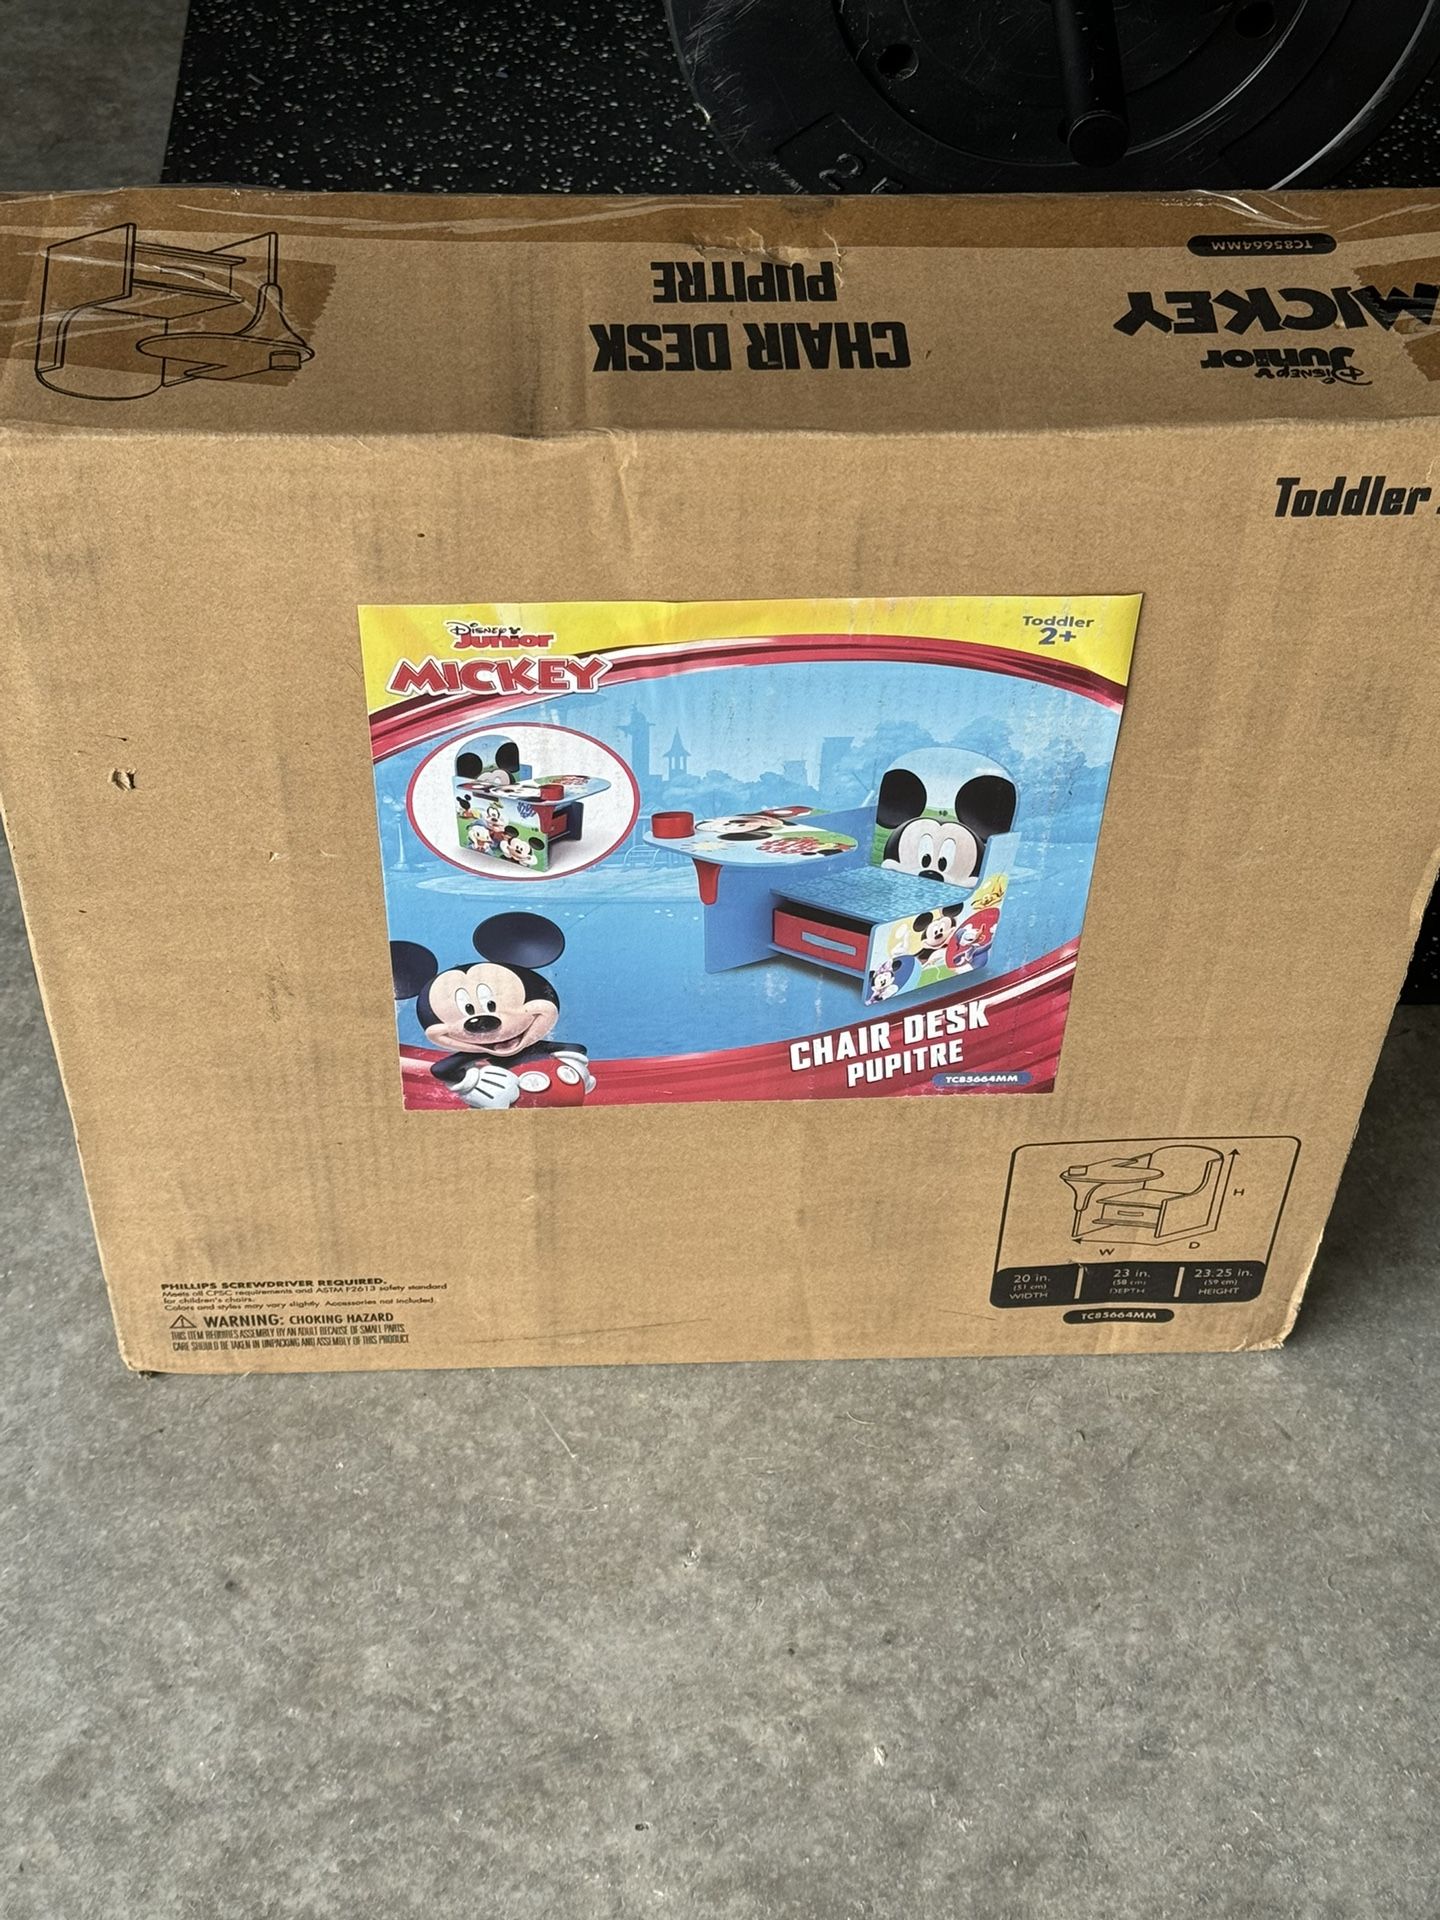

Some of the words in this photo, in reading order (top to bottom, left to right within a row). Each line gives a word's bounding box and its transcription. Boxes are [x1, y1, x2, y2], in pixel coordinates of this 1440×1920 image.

[1211, 240, 1313, 250] TC85664MM
[650, 261, 837, 303] PUPITRE
[1113, 283, 1439, 336] MICKEY
[588, 324, 732, 371] DESK
[743, 322, 912, 370] CHAIR
[1275, 476, 1432, 517] Toddler
[1022, 615, 1095, 628] Toddler
[446, 621, 507, 637] Disney
[1038, 627, 1076, 645] 2+
[390, 656, 608, 692] MICKEY
[789, 1022, 891, 1071] CHAIR
[903, 1000, 990, 1045] DESK
[847, 1039, 964, 1087] PUPITRE
[945, 1075, 1018, 1083] TC85664MM
[1233, 1188, 1245, 1197] H
[1188, 1241, 1201, 1250] D
[1099, 1248, 1115, 1256] W
[1013, 1274, 1031, 1284] 20
[1036, 1273, 1051, 1282] in.
[1113, 1269, 1130, 1278] 23
[1135, 1269, 1151, 1278] in.
[1194, 1268, 1232, 1278] 23.25
[1237, 1268, 1253, 1277] in.
[161, 1283, 217, 1291] PHILLIPS
[221, 1281, 313, 1290] SCREWDRIVER
[318, 1278, 387, 1287] REQUIRED.
[205, 1289, 232, 1297] CPSC
[235, 1288, 293, 1297] requirements
[316, 1286, 343, 1294] ASTM
[380, 1284, 405, 1292] safety
[1009, 1292, 1048, 1300] WIDTH
[1109, 1287, 1145, 1295] DEPTH
[1198, 1287, 1240, 1295] HEIGHT
[180, 1296, 222, 1304] children's
[217, 1303, 241, 1311] styles
[266, 1301, 286, 1309] vary
[203, 1314, 285, 1328] WARNING:
[289, 1314, 343, 1325] CHOKING
[347, 1312, 394, 1323] HAZARD
[1081, 1311, 1156, 1320] TC85664MM
